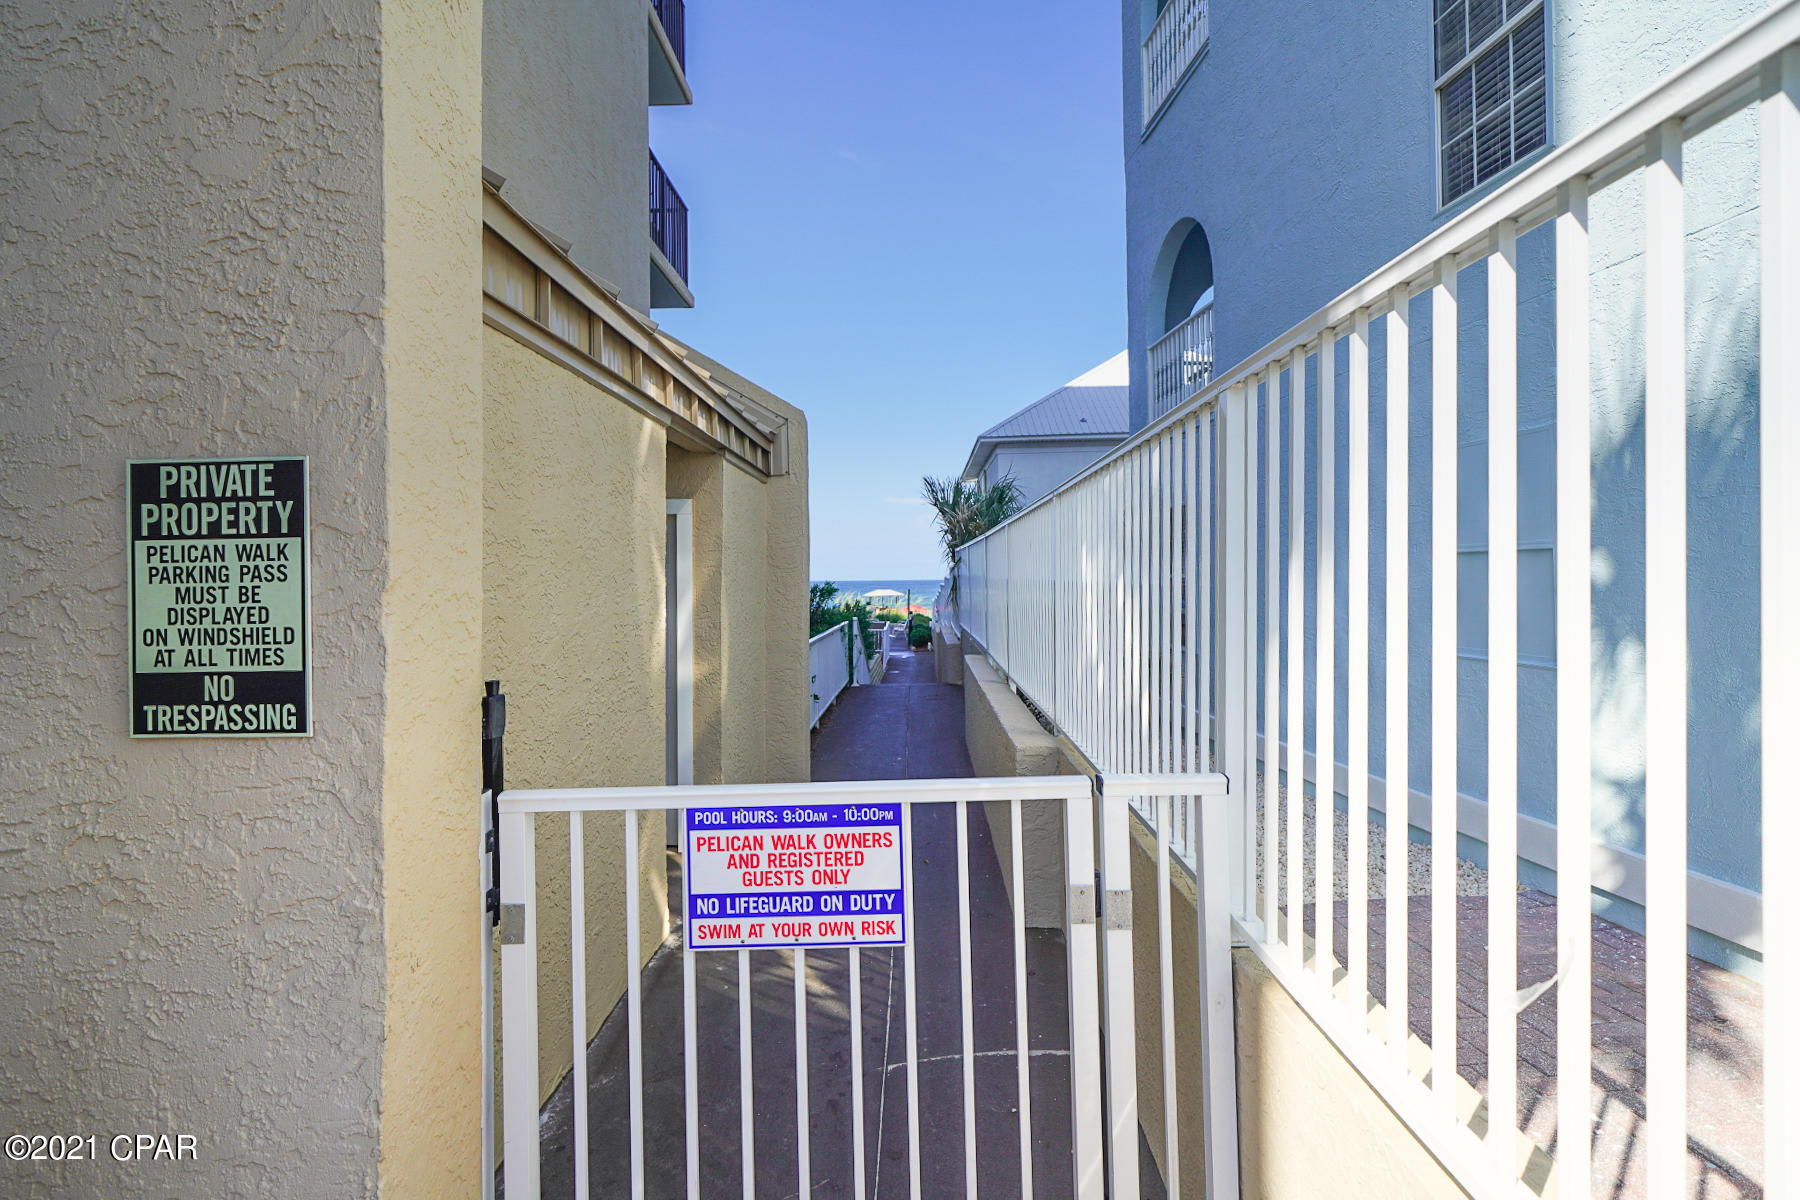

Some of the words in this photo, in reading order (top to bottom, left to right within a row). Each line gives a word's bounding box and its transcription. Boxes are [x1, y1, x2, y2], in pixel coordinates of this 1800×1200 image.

[159, 463, 275, 498] PRIVATE
[141, 501, 293, 536] PROPERTY
[146, 544, 225, 564] PELICAN
[235, 543, 289, 562] WALK
[149, 565, 230, 584] PARKING
[239, 564, 288, 583] PASS
[175, 586, 229, 605] MUST
[238, 585, 261, 603] BE
[167, 606, 269, 626] DISPLAYED
[143, 629, 168, 647] ON
[178, 627, 295, 646] WINDSHIELD
[154, 649, 175, 667] AT
[184, 649, 217, 667] ALL
[226, 648, 284, 666] TIMES
[203, 675, 234, 701] NO
[143, 704, 296, 732] TRESPASSING
[695, 811, 727, 824] POOL
[732, 810, 778, 823] HOURS:
[783, 809, 827, 823] 9:00AM
[844, 808, 893, 821] 10:00PM
[697, 836, 763, 852] PELICAN
[771, 834, 816, 850] WALK
[824, 832, 893, 849] OWNERS
[727, 854, 760, 869] AND
[768, 851, 864, 868] REGISTERED
[742, 870, 804, 887] GUESTS
[812, 869, 850, 885] ONLY
[697, 898, 719, 914] NO
[727, 896, 813, 913] LIFEGUARD
[821, 895, 842, 911] ON
[850, 894, 895, 911] DUTY
[698, 924, 741, 939] SWIM
[748, 923, 765, 938] AT
[772, 923, 811, 937] YOUR
[819, 922, 854, 936] OWN
[862, 920, 896, 935] RISK
